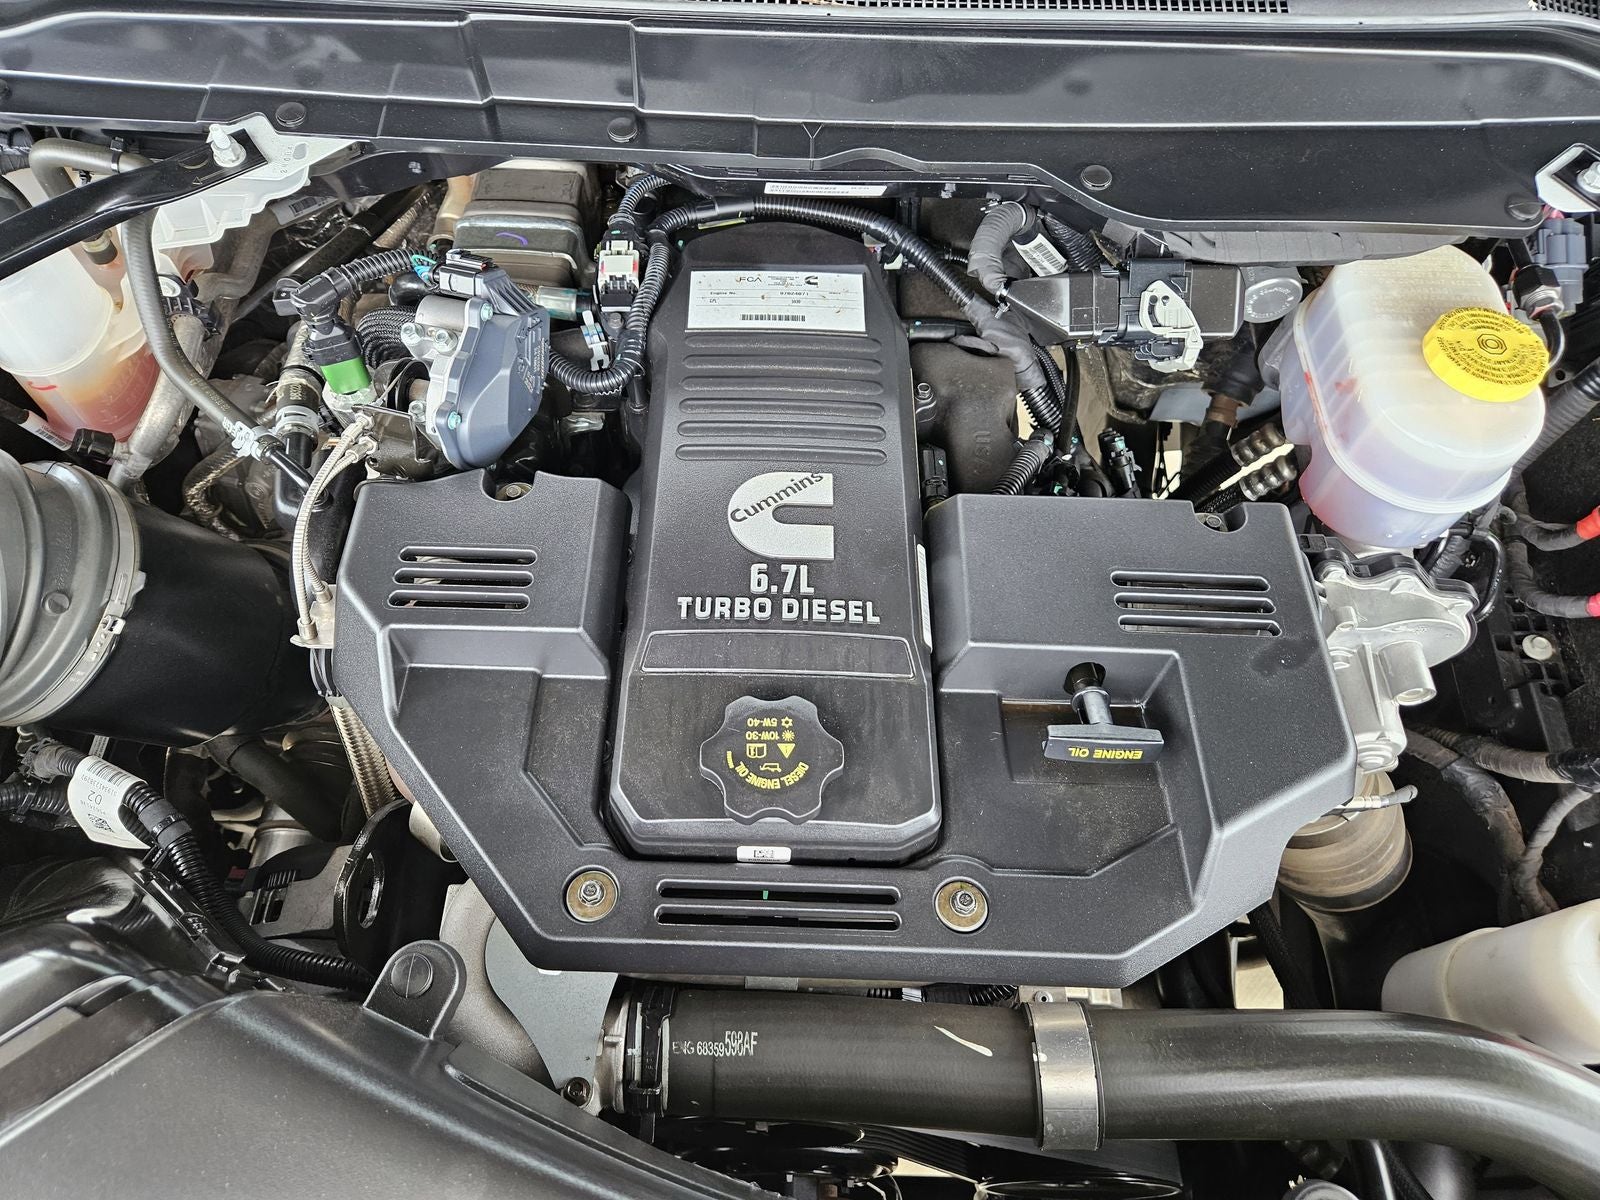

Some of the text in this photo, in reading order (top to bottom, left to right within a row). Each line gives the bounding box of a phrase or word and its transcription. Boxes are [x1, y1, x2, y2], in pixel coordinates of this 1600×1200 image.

[730, 472, 824, 523] Cummins
[749, 563, 815, 595] 6.7L
[677, 596, 881, 624] TURBO DIESEL
[745, 730, 779, 740] 10W-30
[747, 717, 778, 727] 5W-40
[1068, 747, 1143, 759] ENGINE OIL
[735, 761, 810, 789] DIESEL ENGINE OIL
